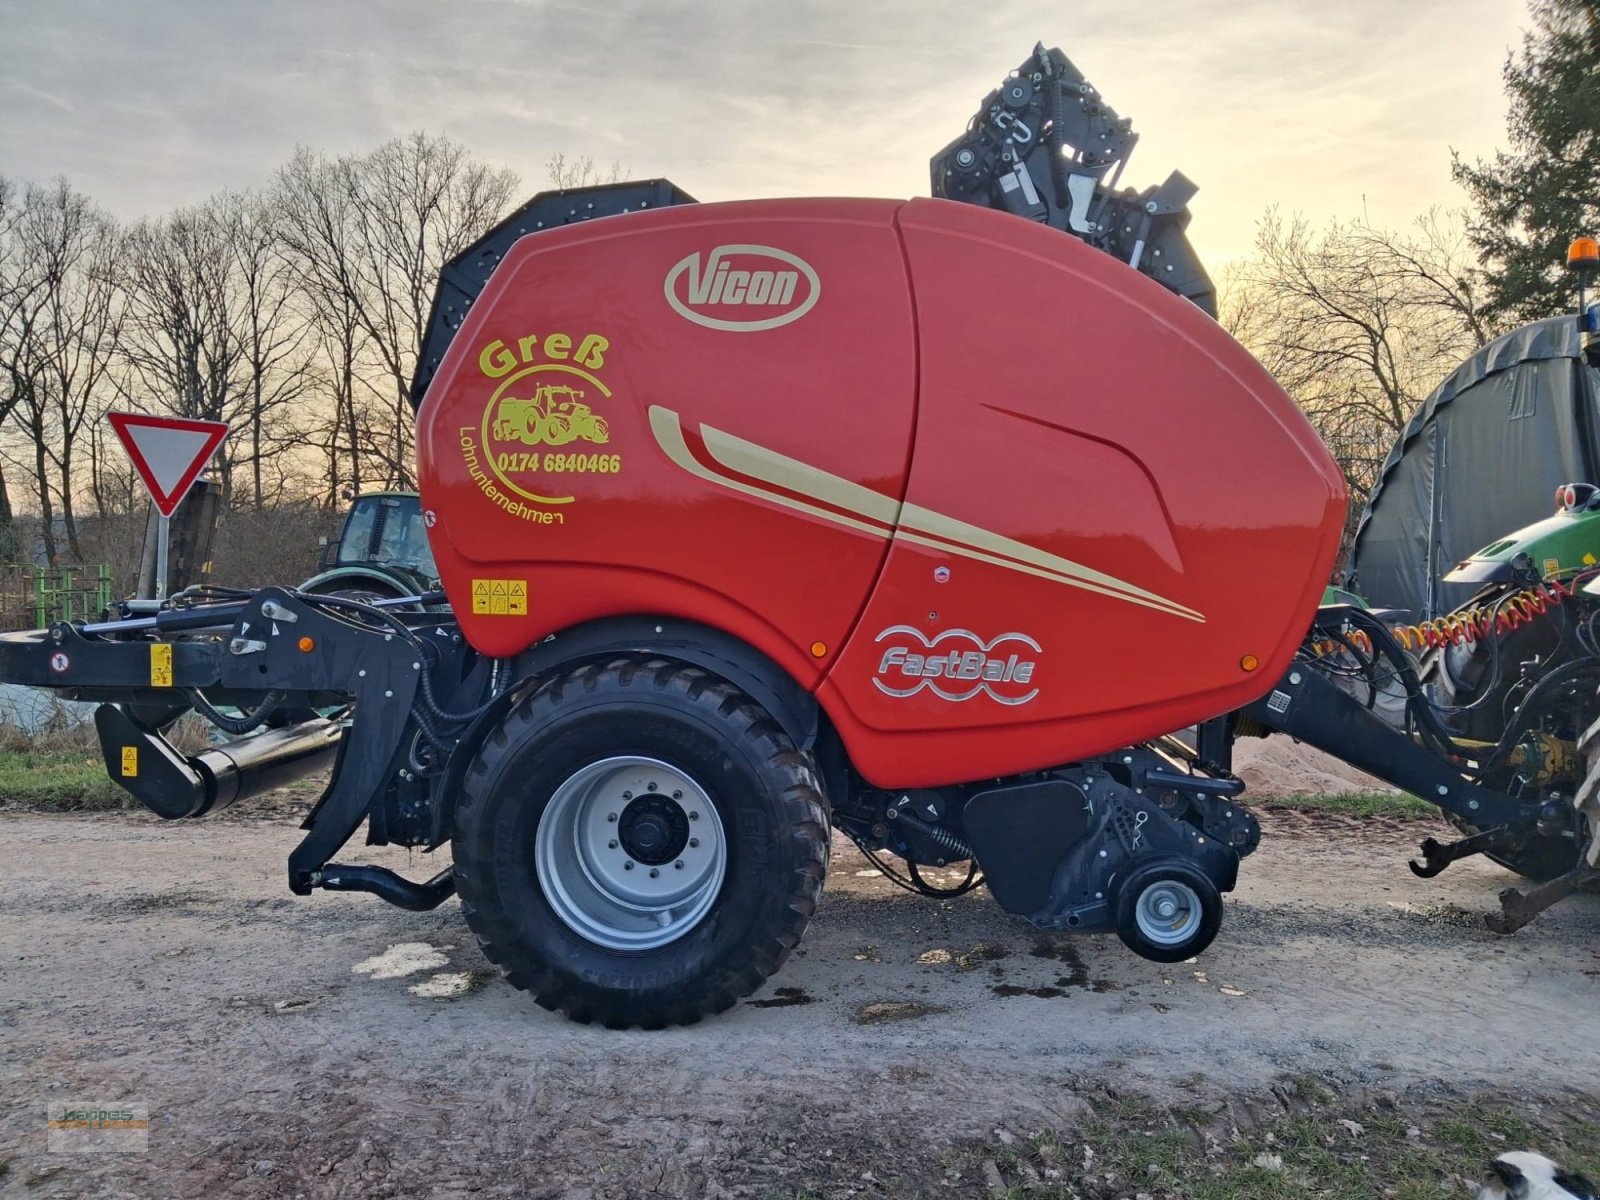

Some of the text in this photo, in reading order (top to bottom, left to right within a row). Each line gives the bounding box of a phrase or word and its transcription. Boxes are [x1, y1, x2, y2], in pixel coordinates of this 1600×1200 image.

[688, 251, 799, 305] Vicon
[479, 333, 610, 378] Greß
[460, 426, 564, 525] Lohnunternehmen
[498, 453, 621, 474] 0174 6840466
[878, 646, 1036, 684] FastBale
